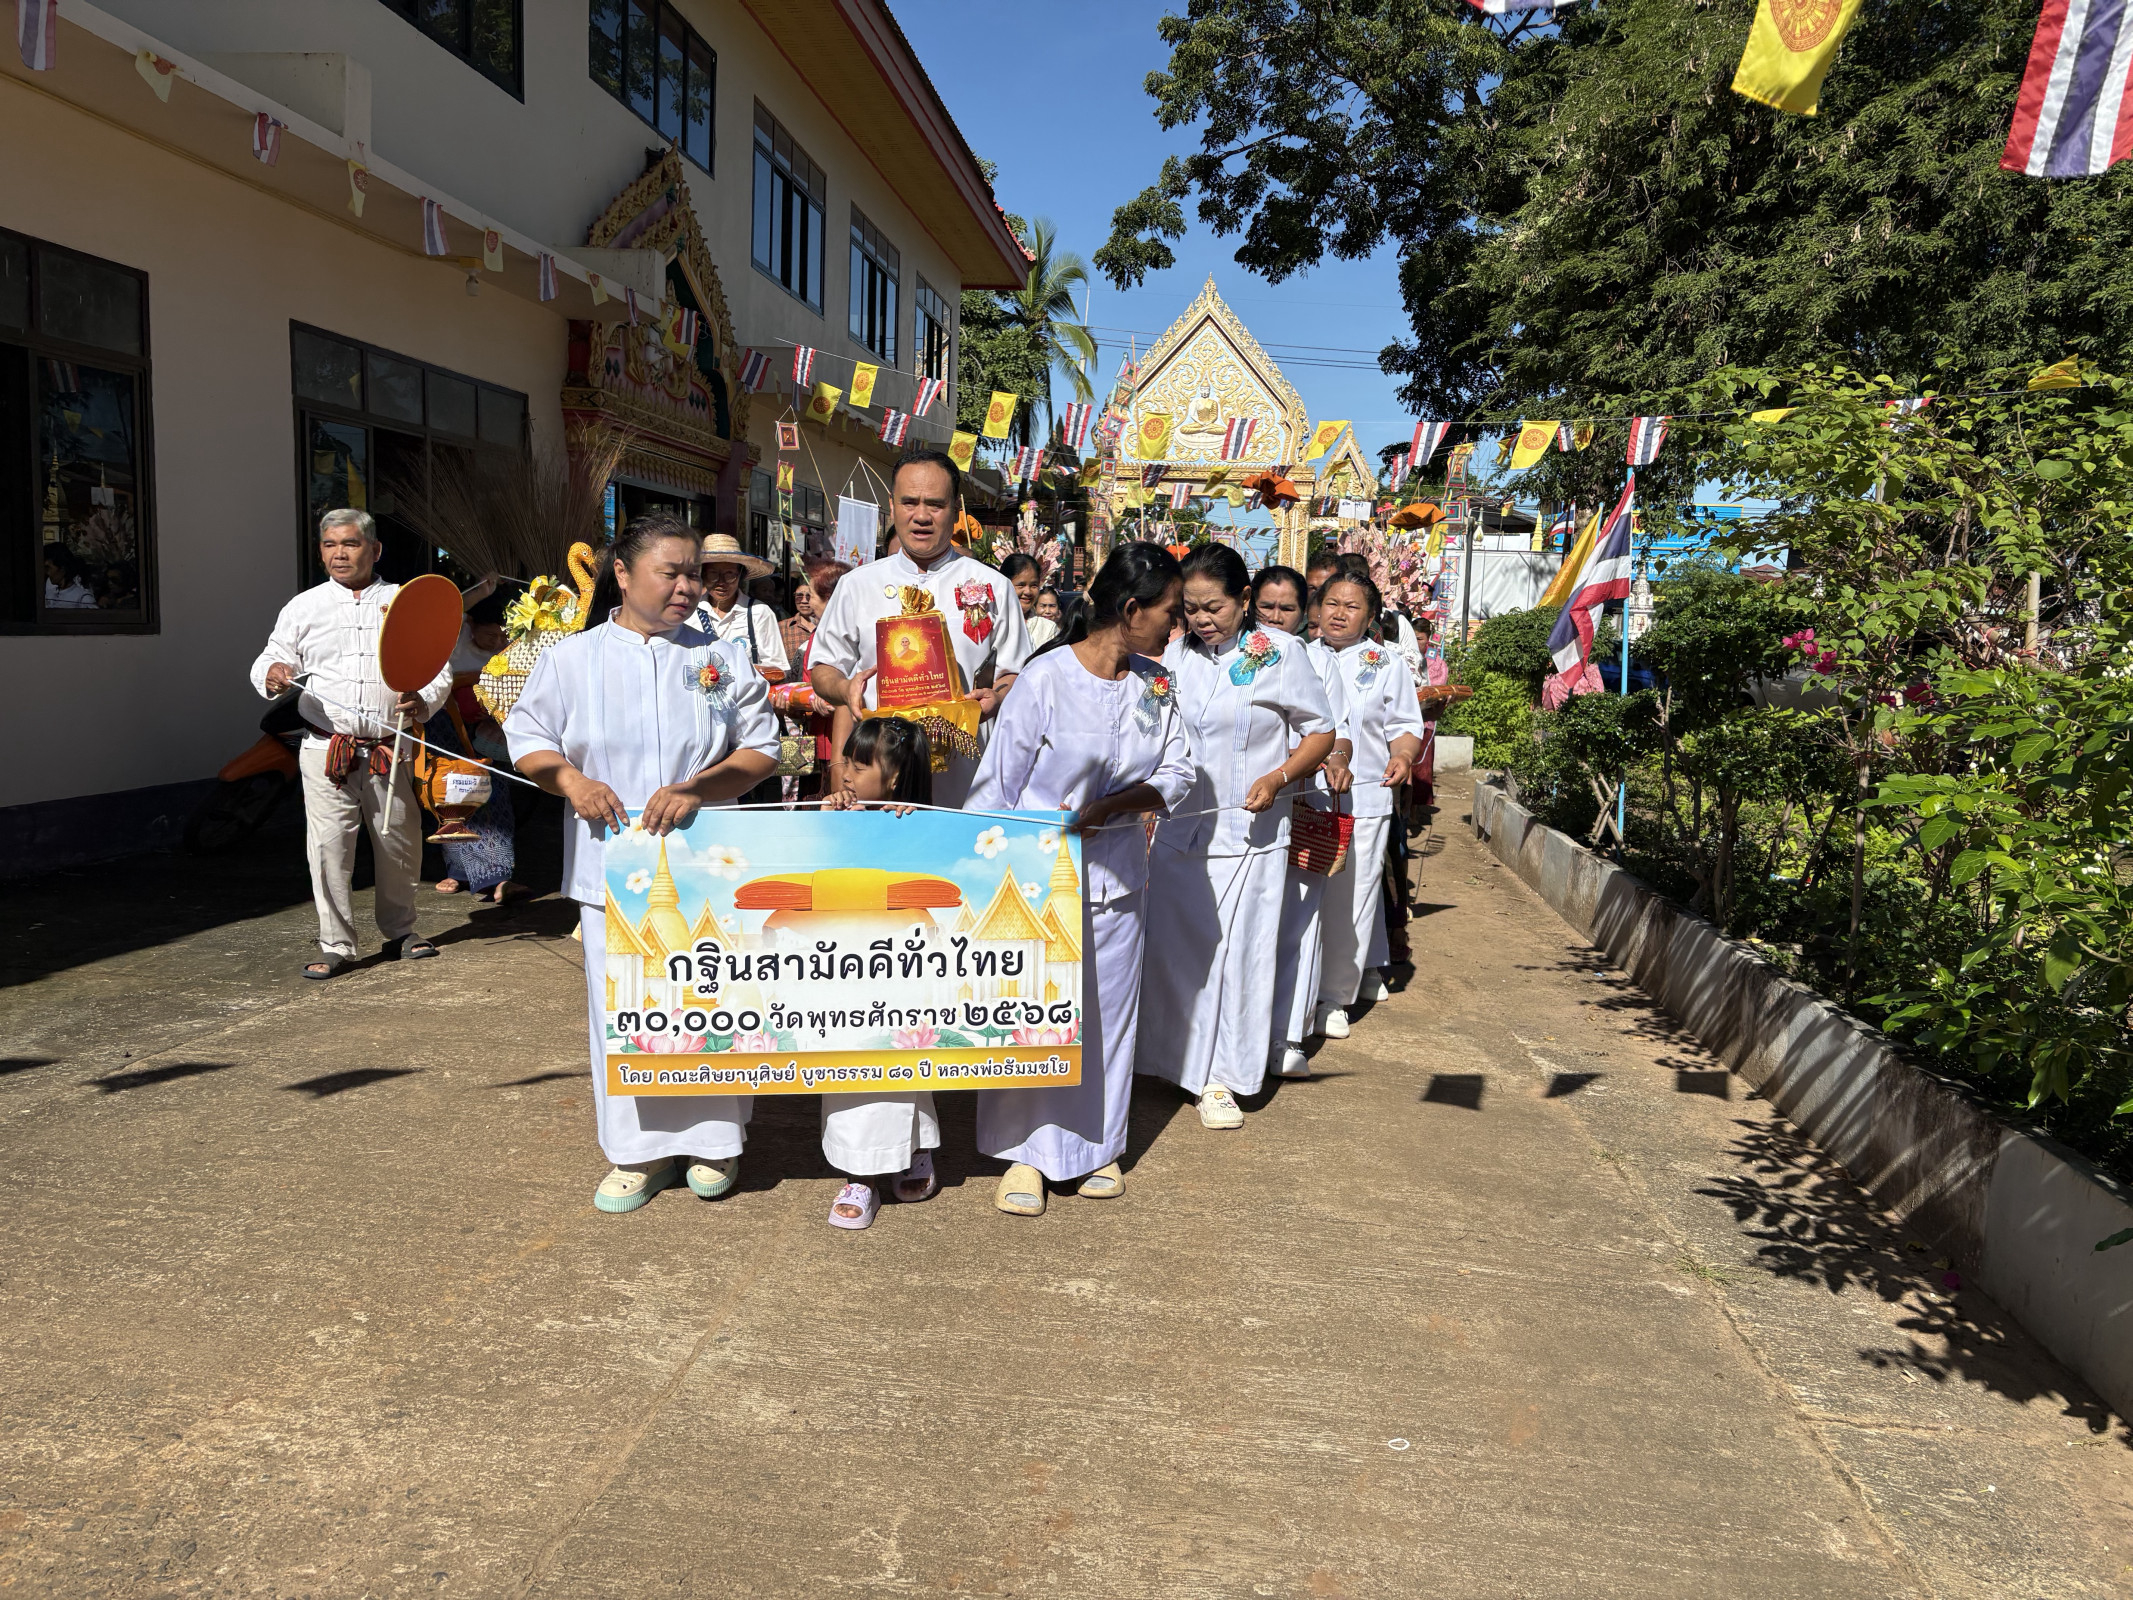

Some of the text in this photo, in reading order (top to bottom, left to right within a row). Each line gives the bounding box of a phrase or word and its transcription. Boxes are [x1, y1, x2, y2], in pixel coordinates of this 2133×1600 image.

[668, 927, 1023, 994] กฐินสามัคคีทั่วไทย
[617, 1010, 761, 1038] ๓๐,๐๐๐
[963, 1000, 1072, 1027] ๒๕๖๘
[619, 1057, 1068, 1088] โดย คณะศิษยานุศิษย์ บูชาธรรม ๘๑ ปี หลวงพ่อธัมมชโย
